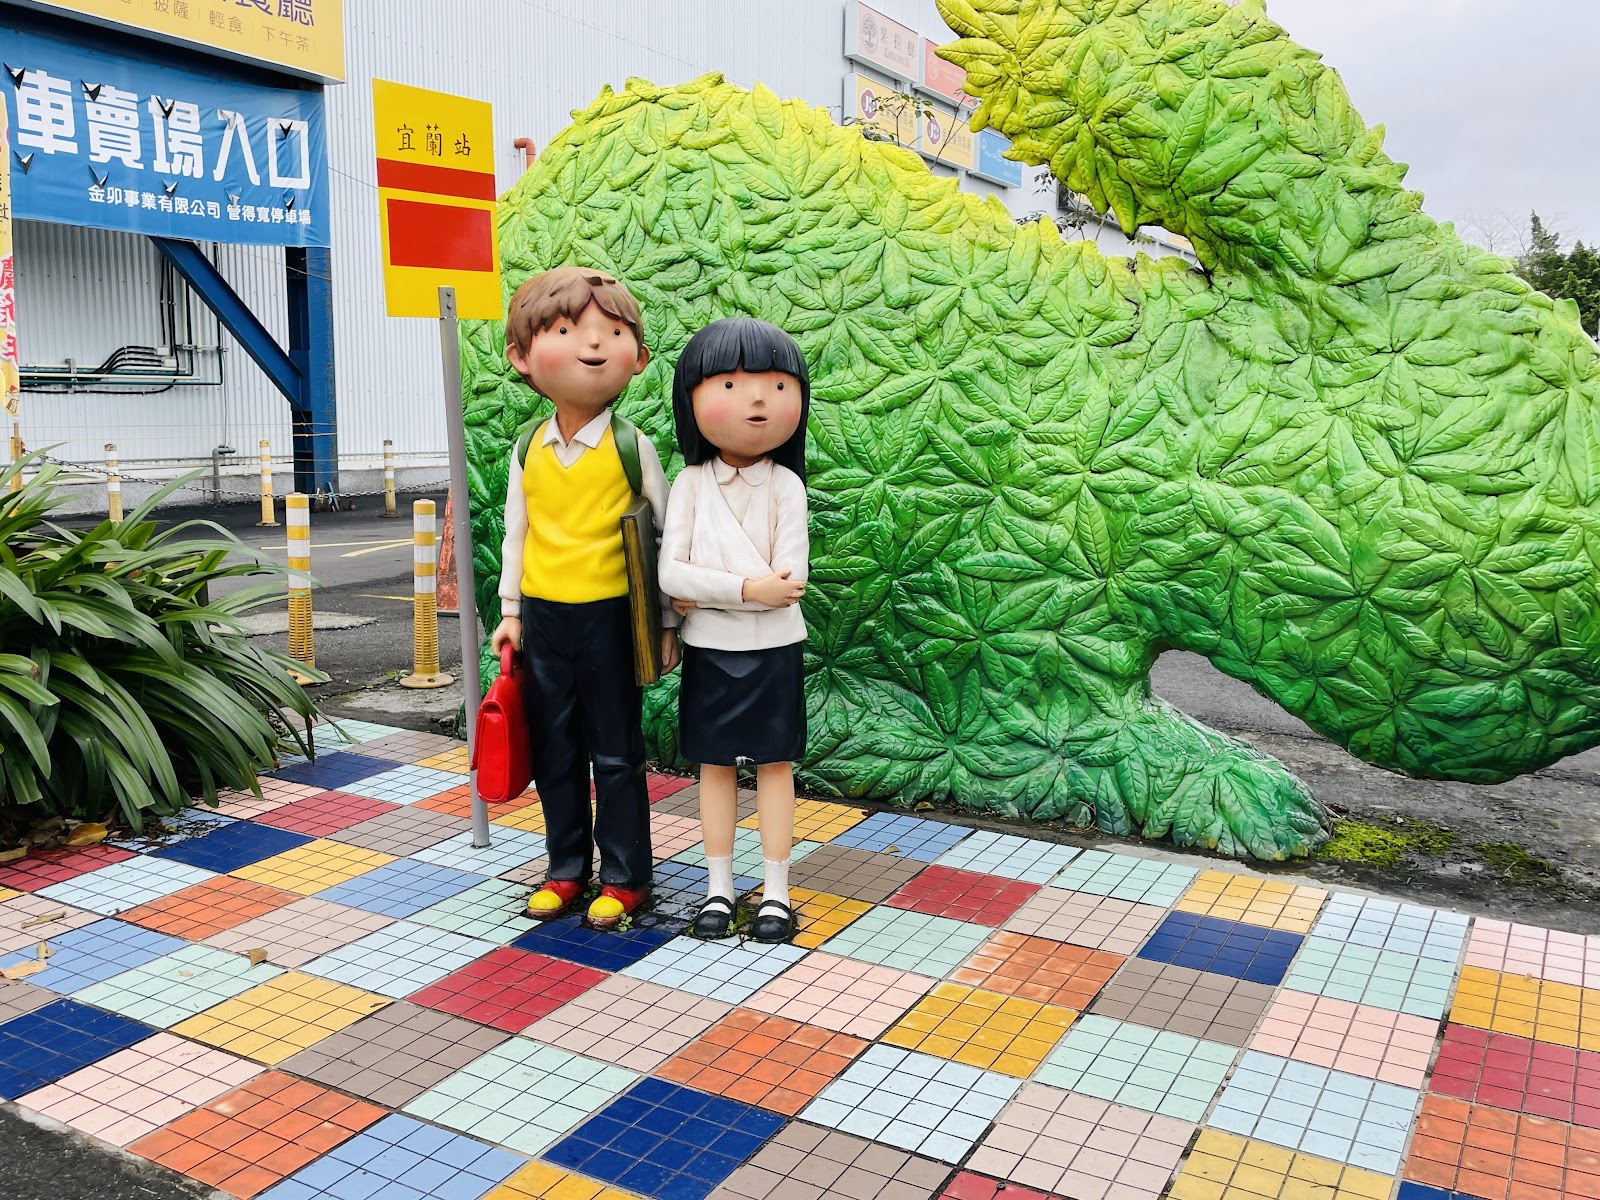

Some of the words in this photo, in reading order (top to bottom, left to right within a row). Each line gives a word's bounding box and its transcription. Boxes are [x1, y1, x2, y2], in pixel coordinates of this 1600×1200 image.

[208, 9, 244, 35] 輕食
[261, 25, 310, 53] 下午茶
[12, 66, 311, 190] 車賣場入口
[396, 123, 472, 157] 宜蘭站
